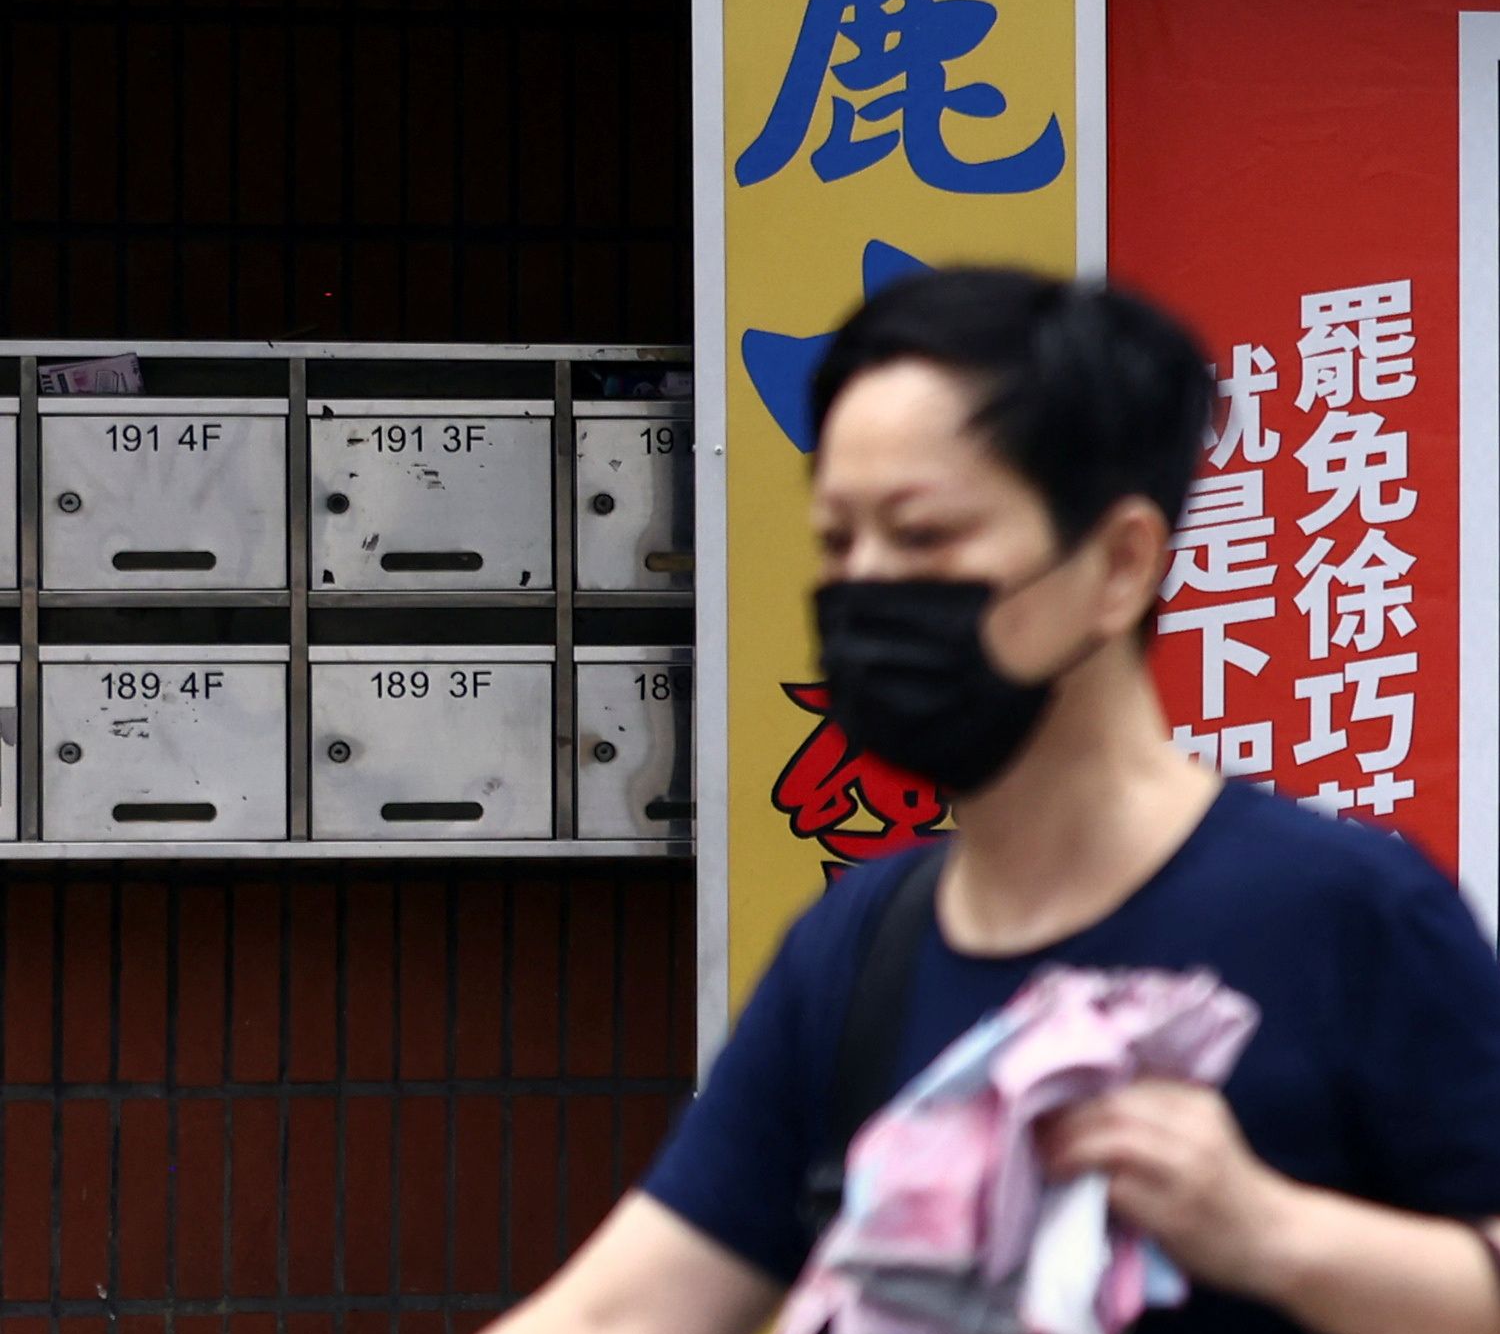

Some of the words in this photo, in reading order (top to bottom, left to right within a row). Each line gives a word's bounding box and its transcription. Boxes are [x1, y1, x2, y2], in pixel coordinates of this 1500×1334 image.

[106, 424, 160, 452] 191
[178, 424, 223, 452] 4F
[370, 425, 424, 453] 191
[442, 425, 487, 453] 3F
[100, 672, 161, 700] 189
[179, 672, 225, 700] 4F
[370, 671, 430, 699] 189
[449, 671, 493, 699] 3F
